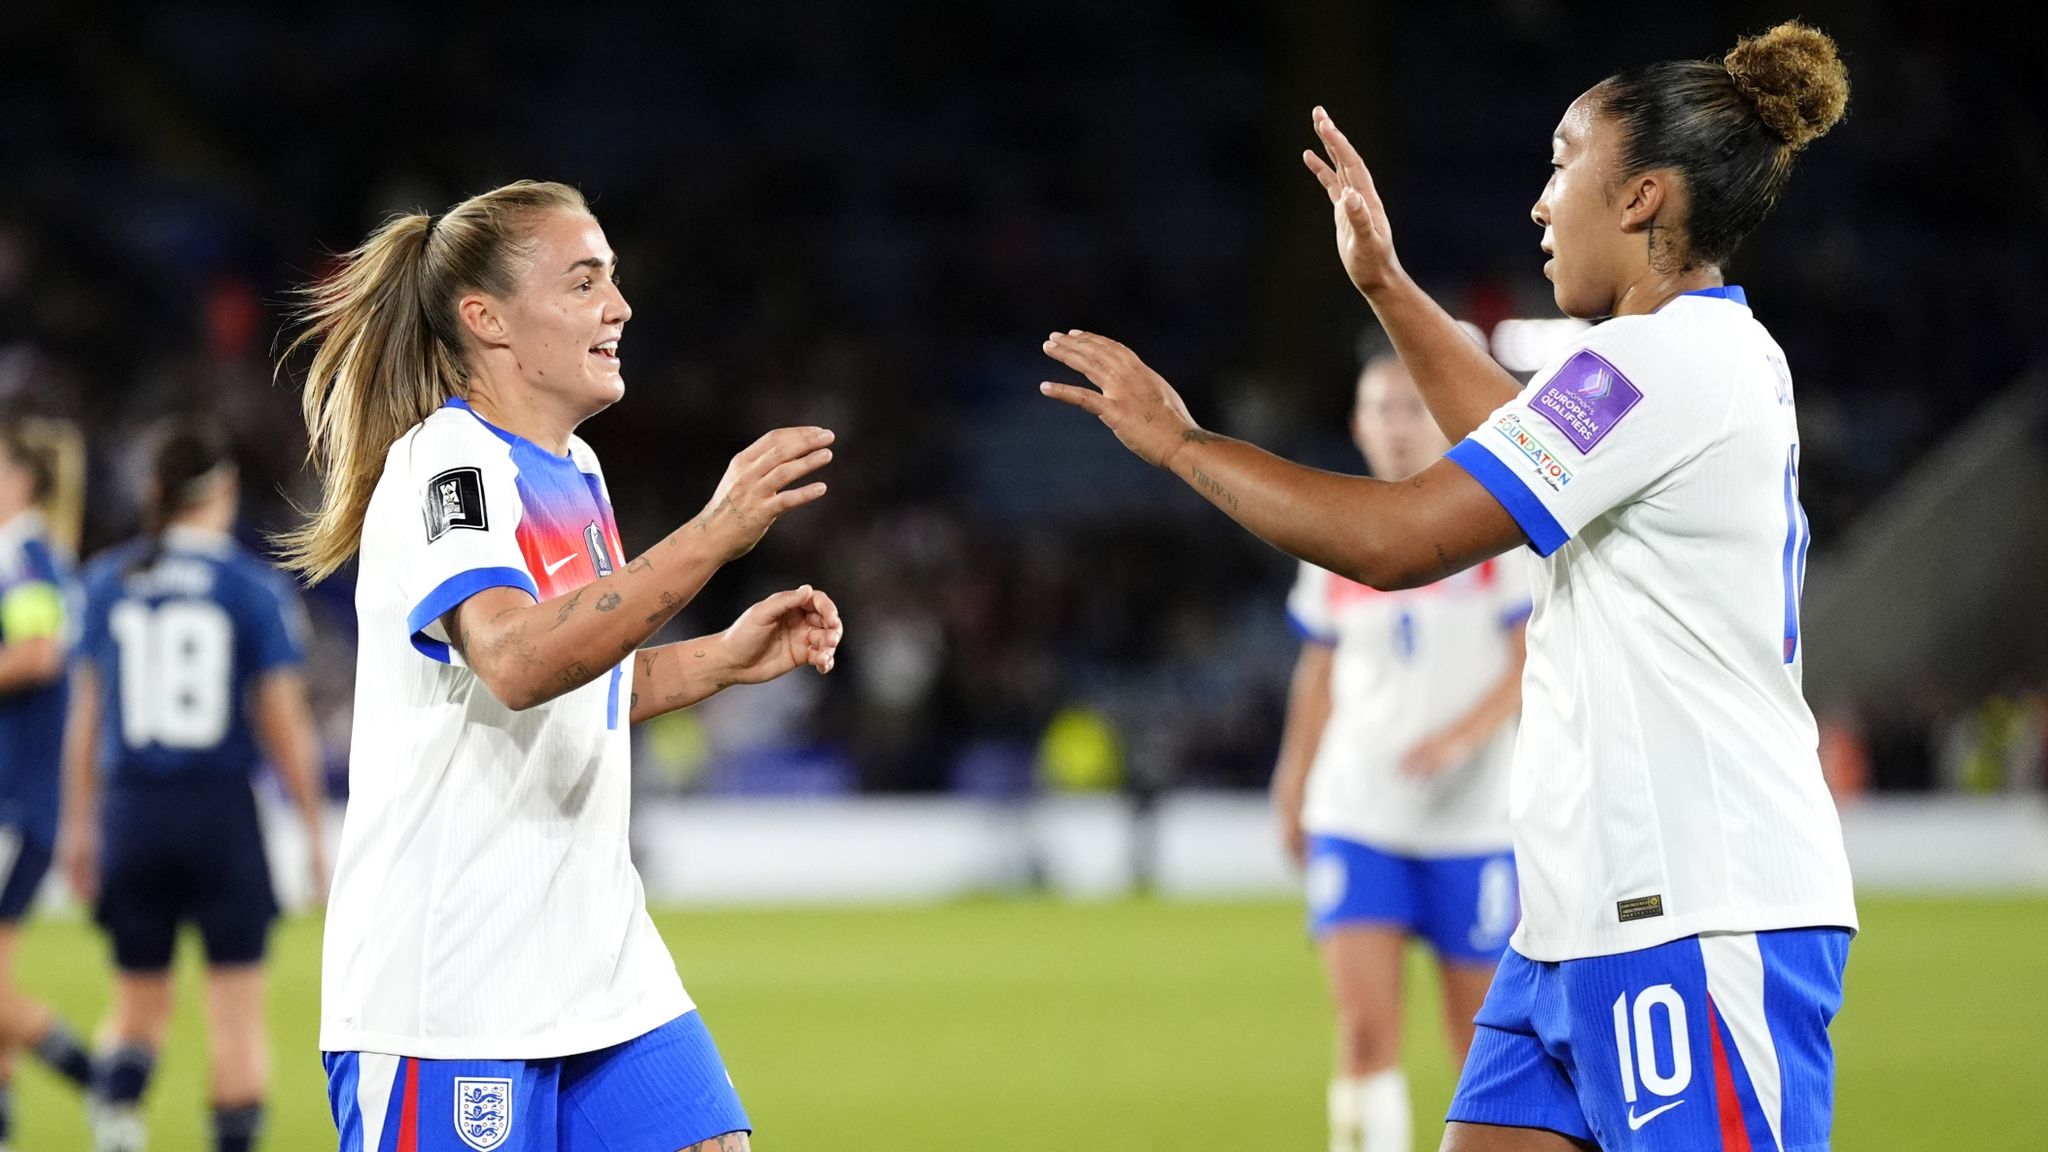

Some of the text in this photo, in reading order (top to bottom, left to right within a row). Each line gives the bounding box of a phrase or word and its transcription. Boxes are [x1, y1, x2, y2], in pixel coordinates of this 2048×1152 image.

[1540, 394, 1593, 441] QUALIFIERS
[1548, 387, 1599, 432] EUROPEAN
[110, 601, 232, 748] 18
[1613, 983, 1692, 1103] 10
